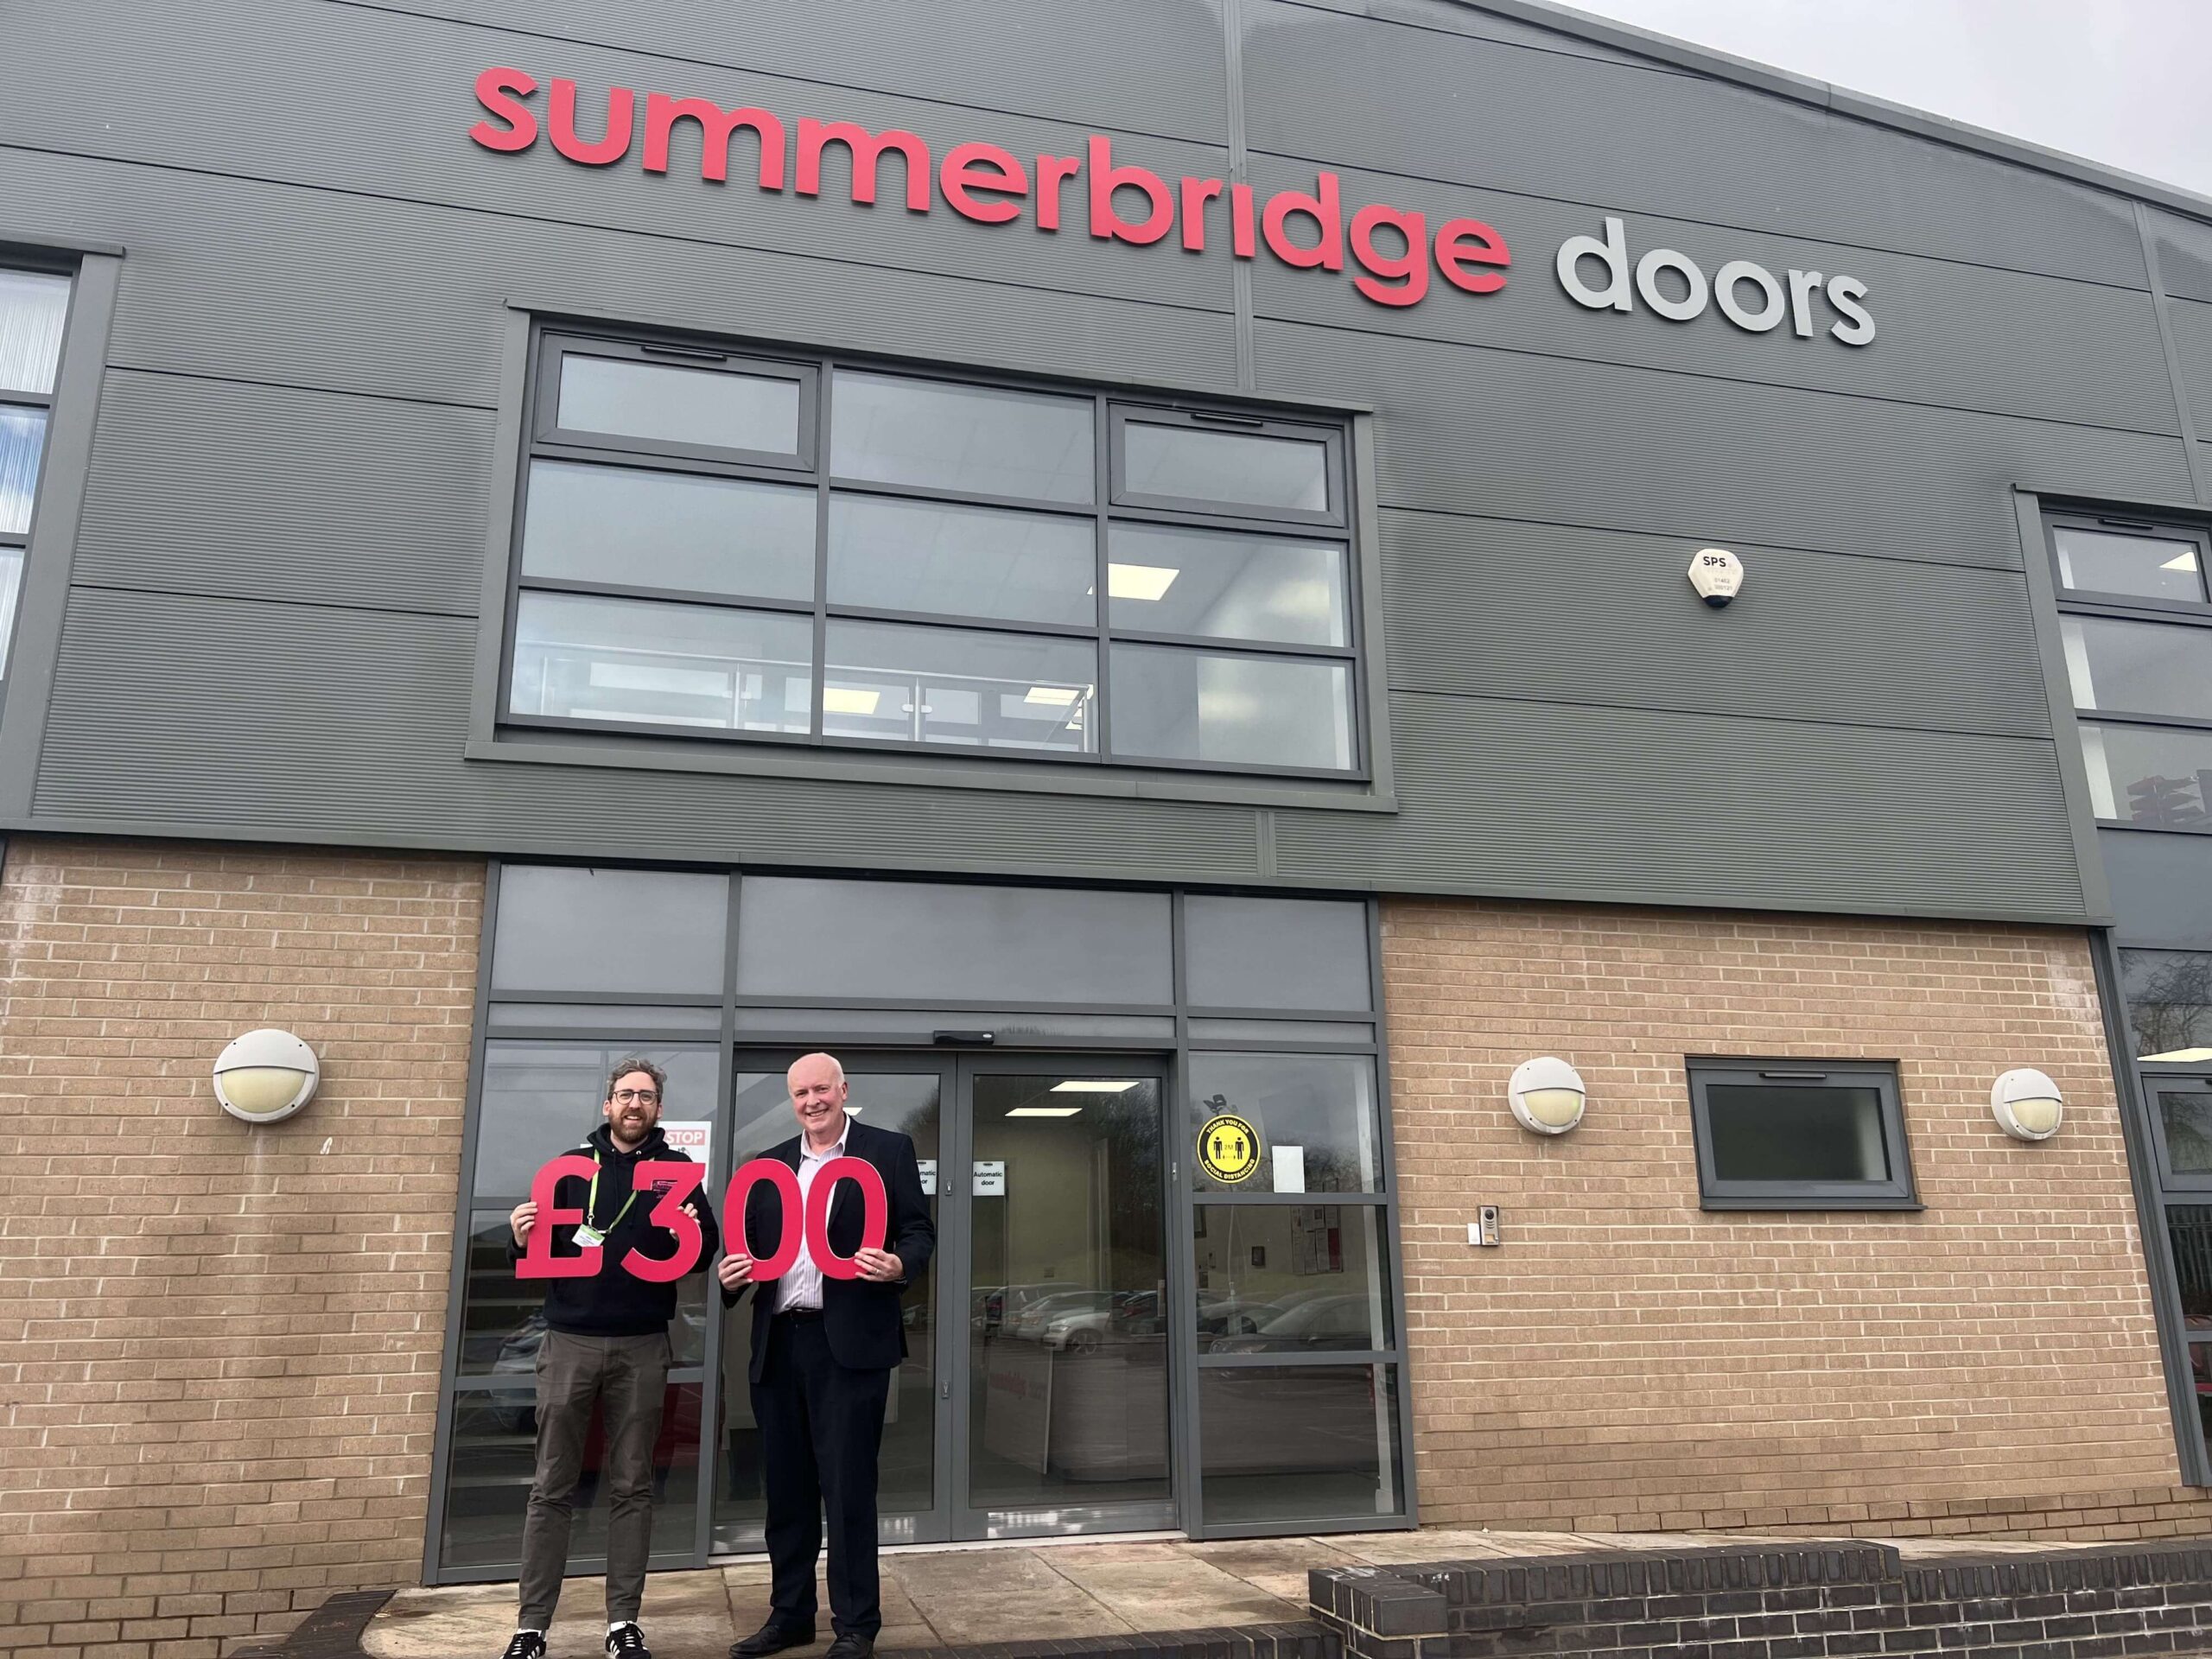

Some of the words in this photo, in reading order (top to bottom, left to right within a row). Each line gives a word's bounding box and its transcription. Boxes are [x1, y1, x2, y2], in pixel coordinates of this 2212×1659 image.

[469, 67, 1511, 306] summerbridge
[1556, 217, 1876, 346] doors
[1703, 556, 1726, 567] SPS
[1206, 1120, 1224, 1134] THANK
[1238, 1123, 1249, 1134] FOR
[666, 1131, 703, 1144] STOP
[1205, 1160, 1224, 1178] SOCIAL
[1224, 1159, 1255, 1179] DISTANCING
